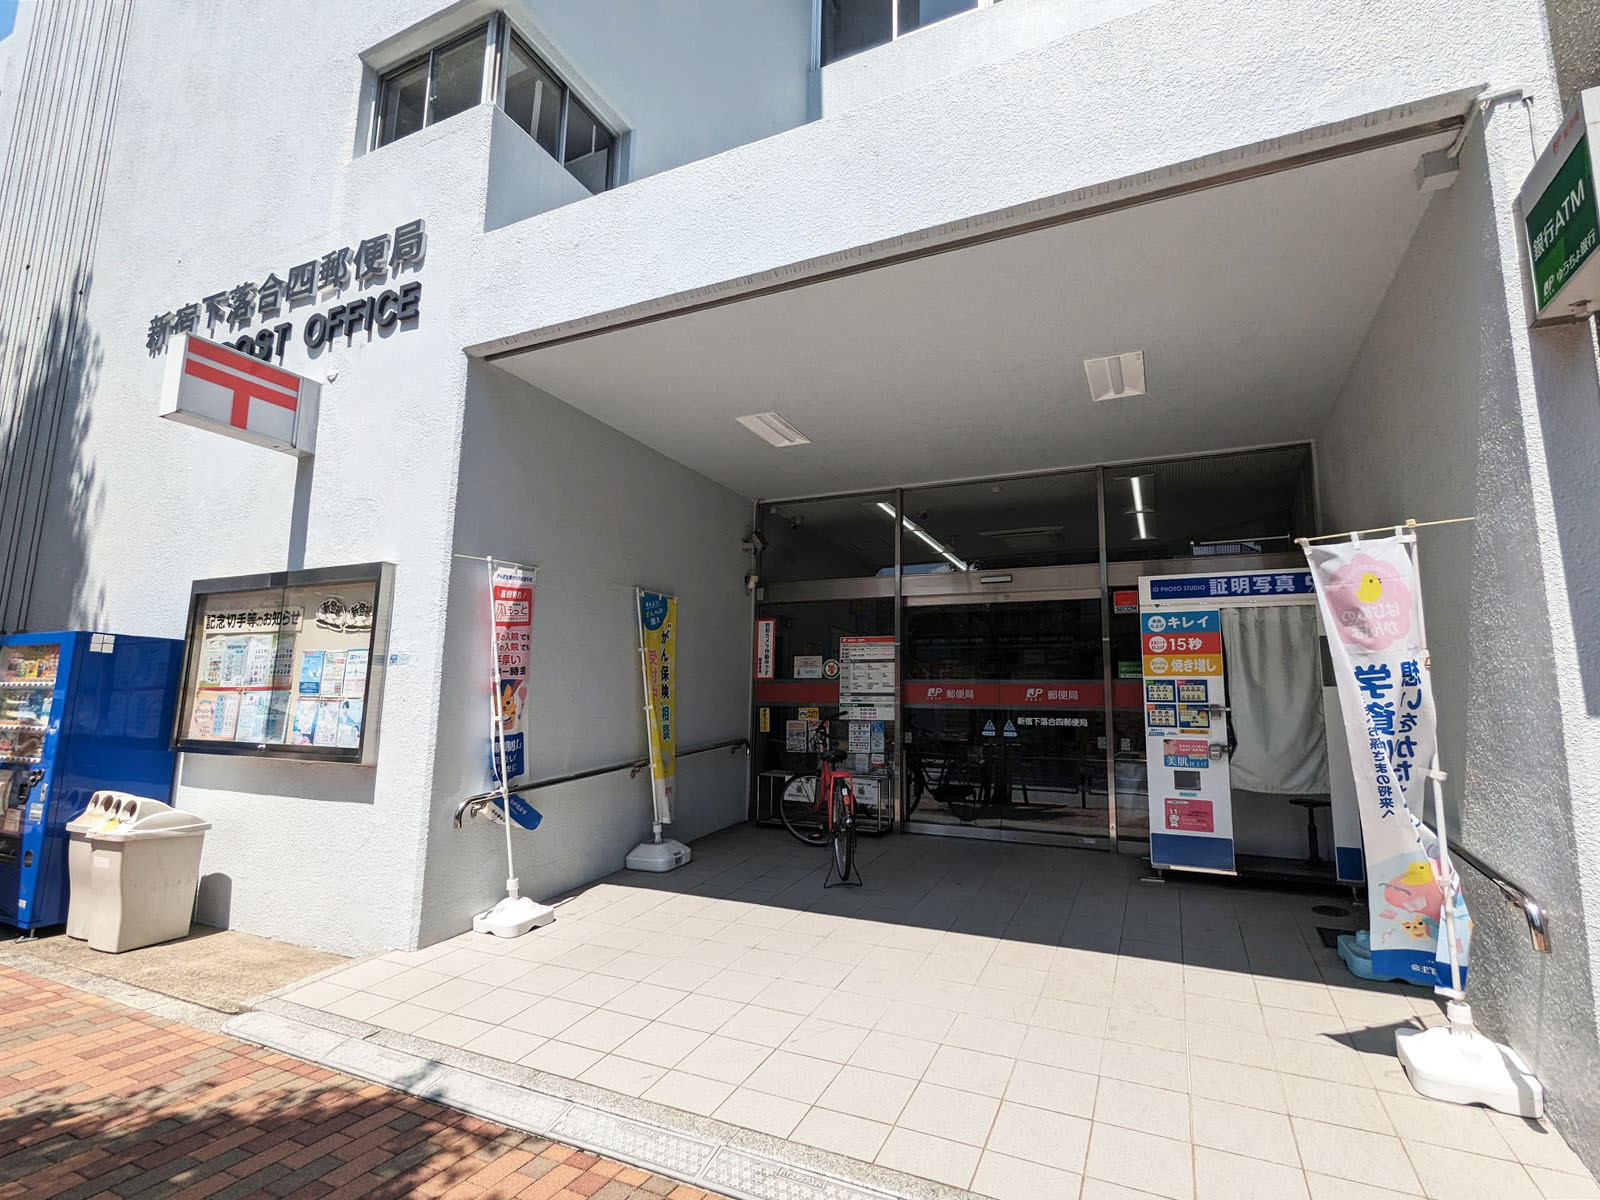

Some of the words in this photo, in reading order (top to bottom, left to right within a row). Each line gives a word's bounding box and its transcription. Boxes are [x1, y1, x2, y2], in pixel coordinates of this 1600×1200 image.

[1556, 228, 1596, 283] ゆうちょ銀行
[146, 218, 426, 352] 新宿下落合四郵便局
[222, 321, 293, 362] OST
[303, 281, 422, 349] OFFICE
[1209, 575, 1295, 595] 証明写真
[206, 610, 300, 630] 記念切手等のお知らせ
[1167, 615, 1209, 629] キレイ
[1168, 637, 1203, 651] 15秒
[1170, 658, 1218, 672] 焼き増し
[946, 689, 974, 699] 郵便局
[1047, 690, 1079, 700] 郵便局
[1017, 717, 1088, 728] 新宿下落合四郵便局
